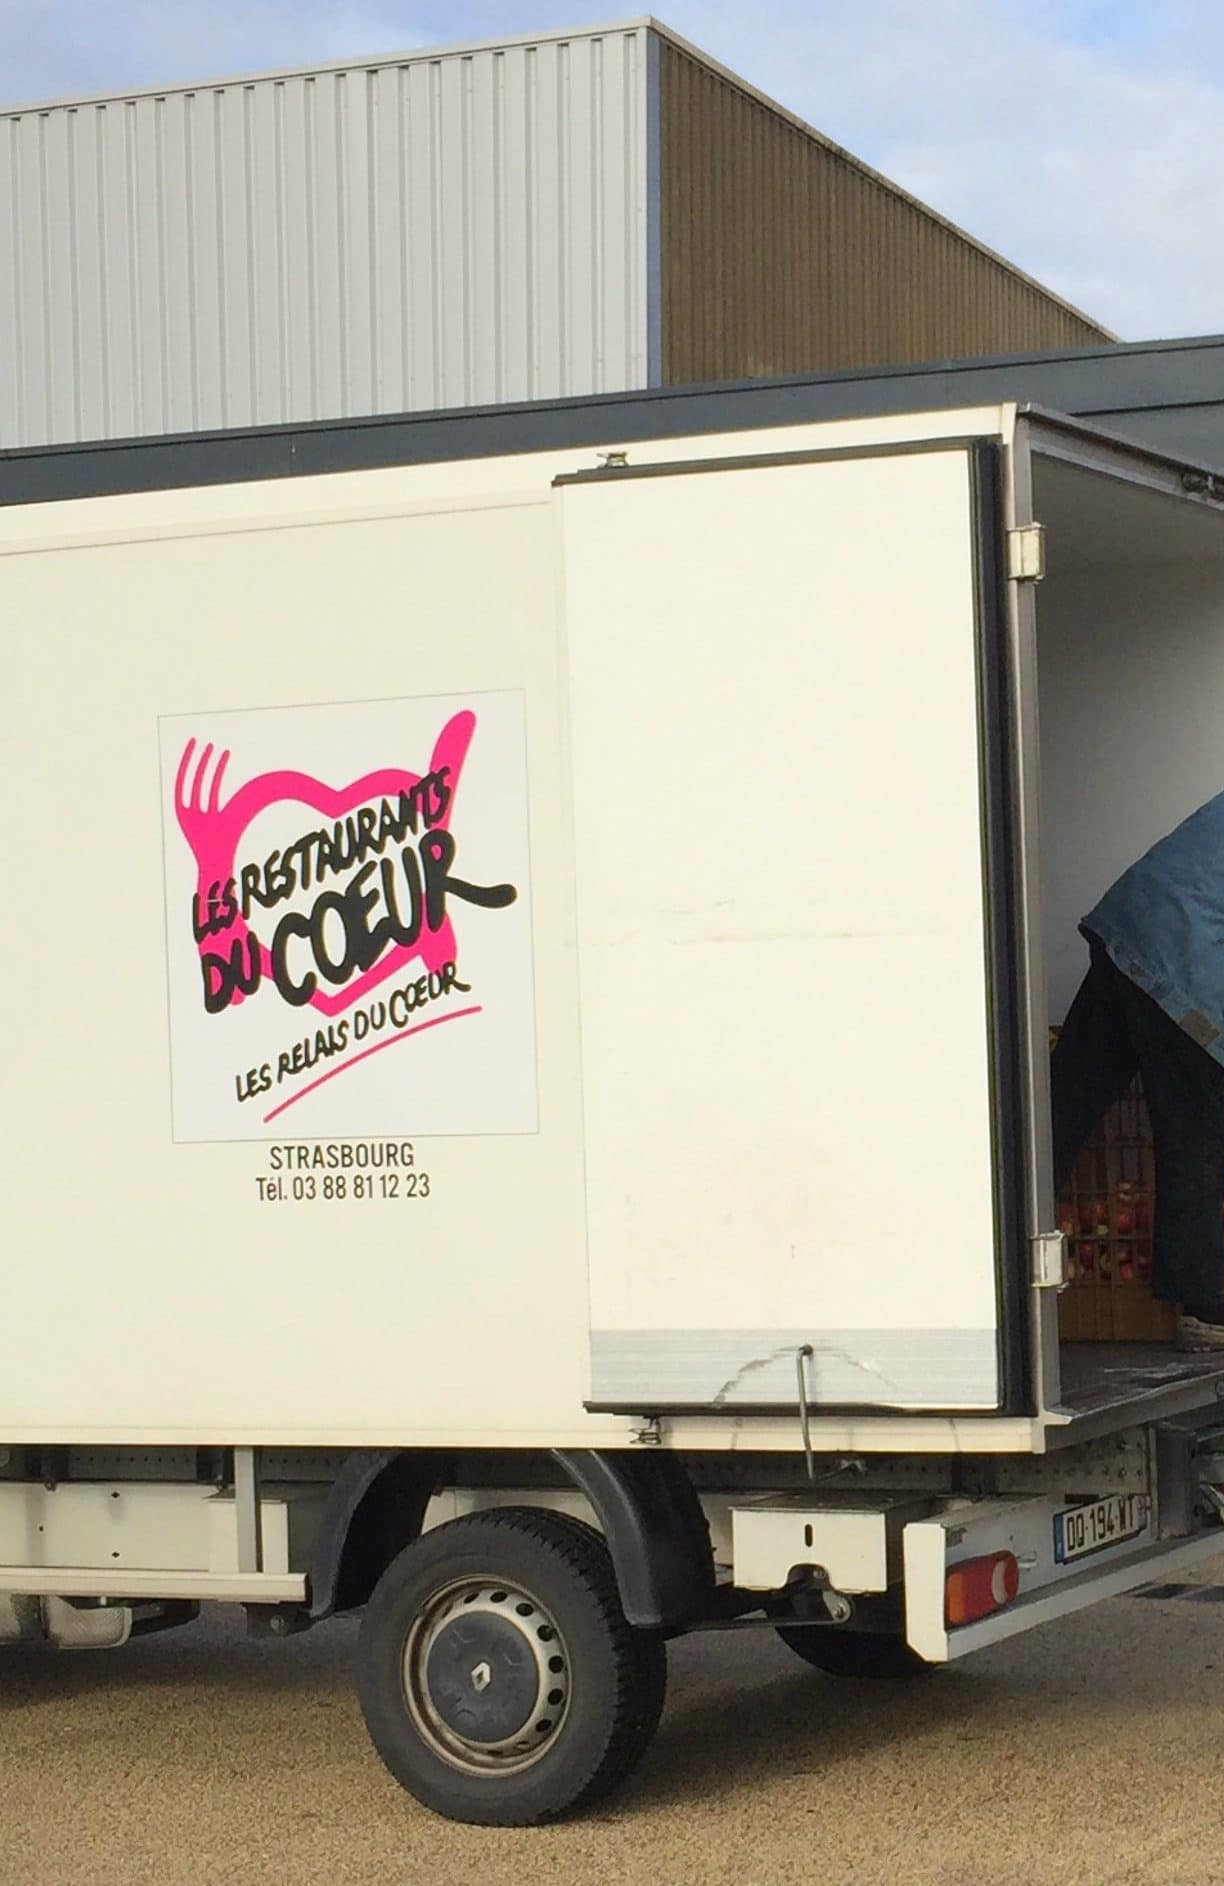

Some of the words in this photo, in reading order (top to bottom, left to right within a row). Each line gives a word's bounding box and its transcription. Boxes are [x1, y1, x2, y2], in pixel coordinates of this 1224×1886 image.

[193, 877, 239, 944] LES
[241, 766, 451, 920] RESTAURANTS
[201, 930, 262, 1014] DU
[235, 1063, 273, 1103] LES
[277, 1019, 350, 1084] RELAIS
[353, 1002, 387, 1041] DU
[255, 1176, 288, 1201] Tél.
[292, 1175, 317, 1201] 03
[322, 1174, 347, 1200] 88
[352, 1173, 374, 1199] 81
[378, 1172, 400, 1199] 12
[406, 1172, 431, 1198] 23
[269, 1142, 415, 1170] STRASBOURG
